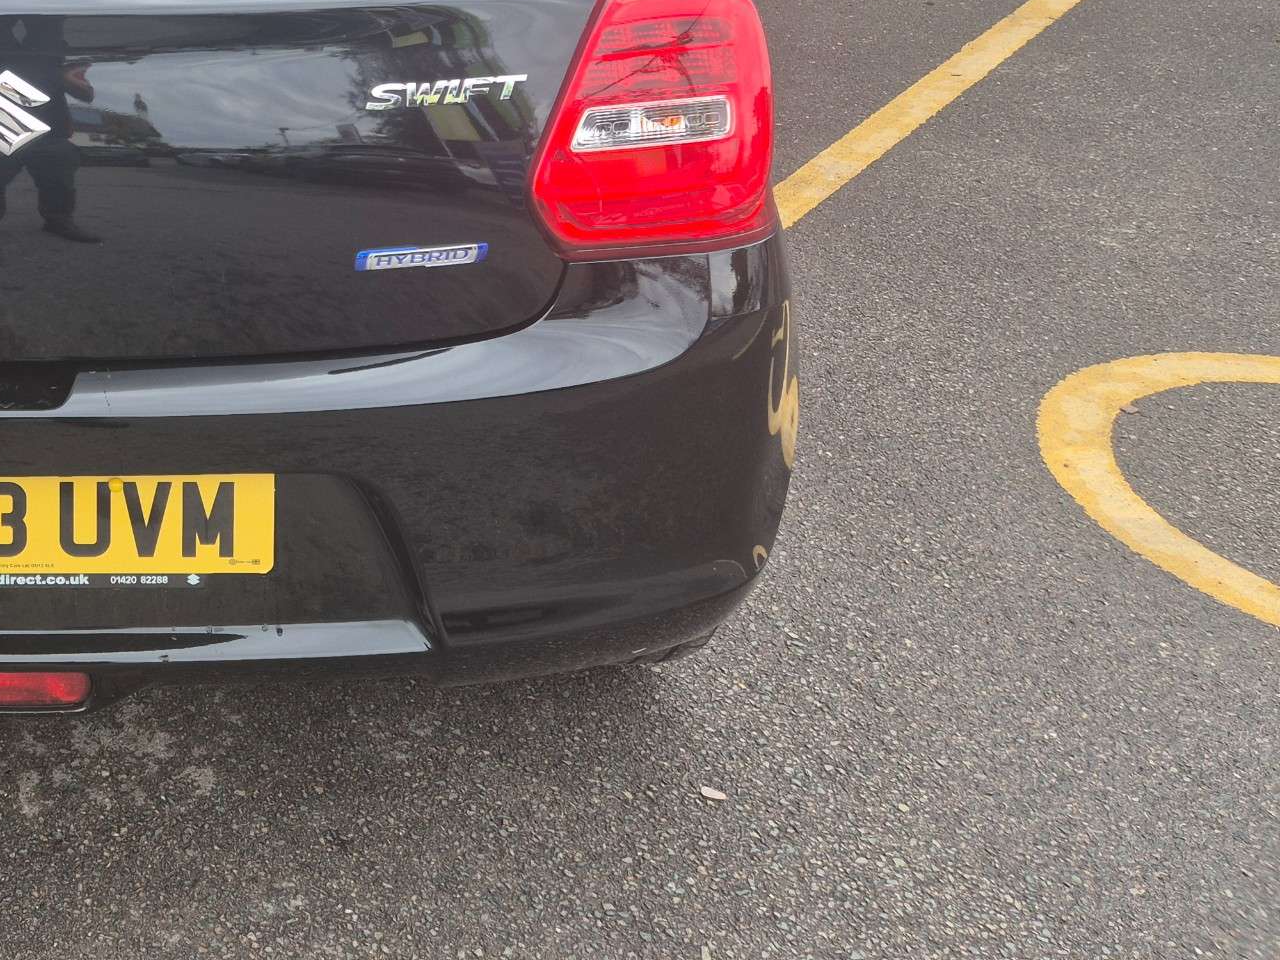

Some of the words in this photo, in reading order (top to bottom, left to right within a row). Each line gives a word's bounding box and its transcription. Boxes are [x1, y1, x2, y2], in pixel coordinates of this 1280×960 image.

[365, 74, 528, 110] SWIFT
[375, 248, 469, 266] HYBRID
[59, 481, 235, 558] UVM
[110, 576, 137, 585] 01420
